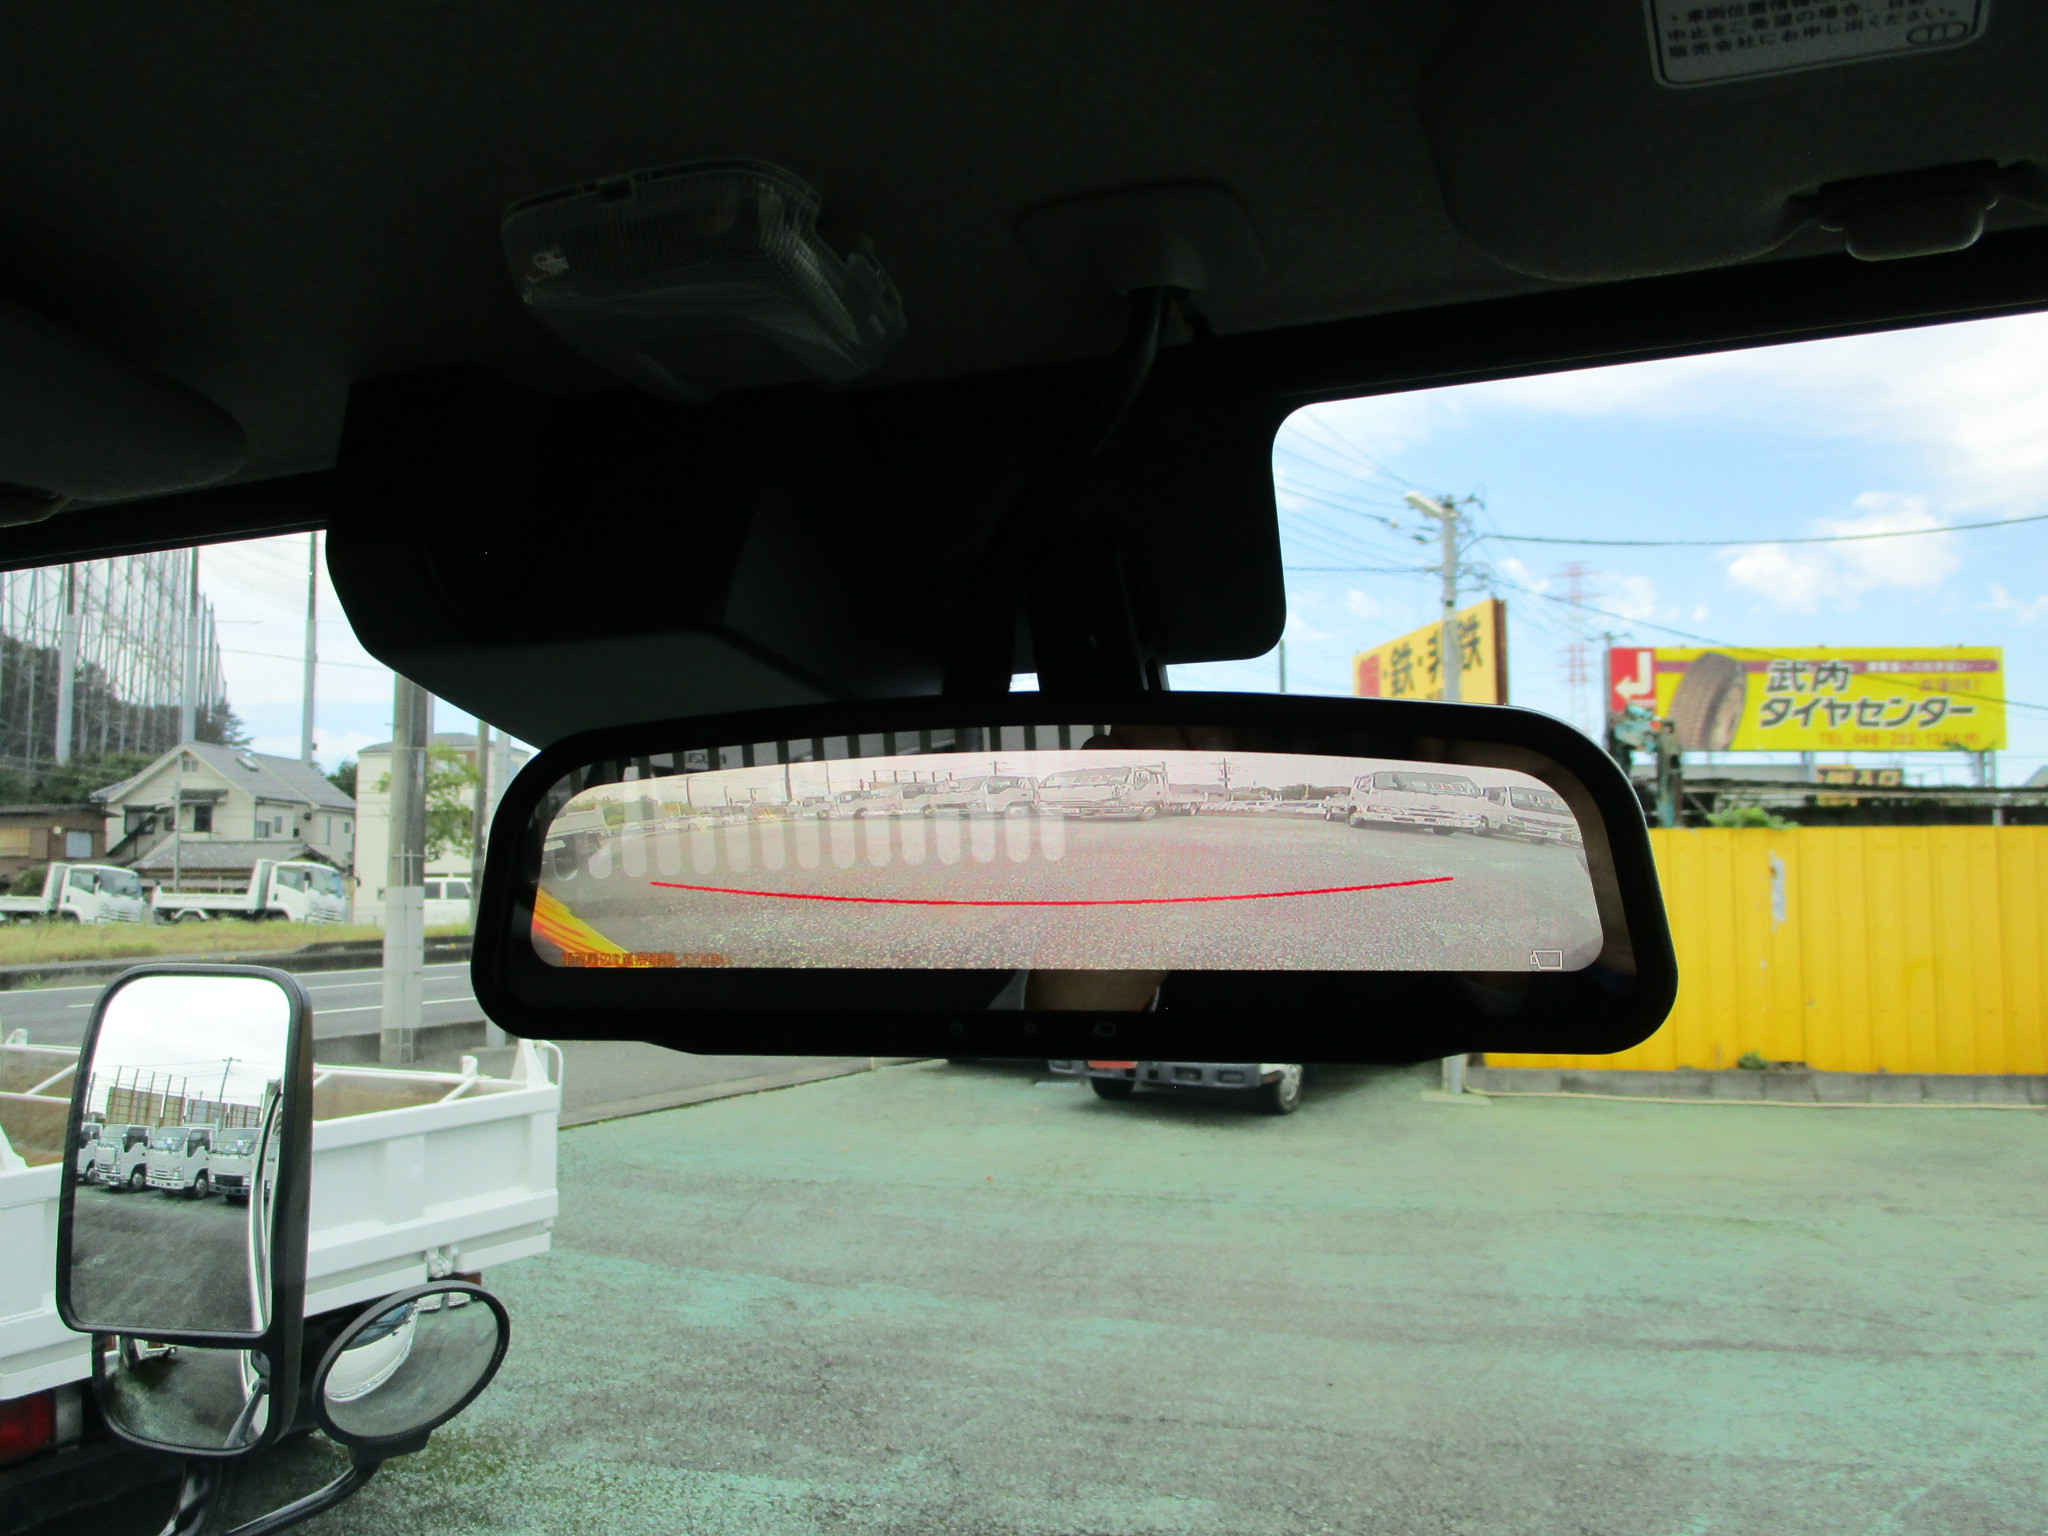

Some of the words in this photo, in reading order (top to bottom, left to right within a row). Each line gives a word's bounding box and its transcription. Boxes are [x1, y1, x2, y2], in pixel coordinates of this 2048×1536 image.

[1765, 659, 1854, 694] 武内
[1758, 697, 1977, 730] タイヤセンター
